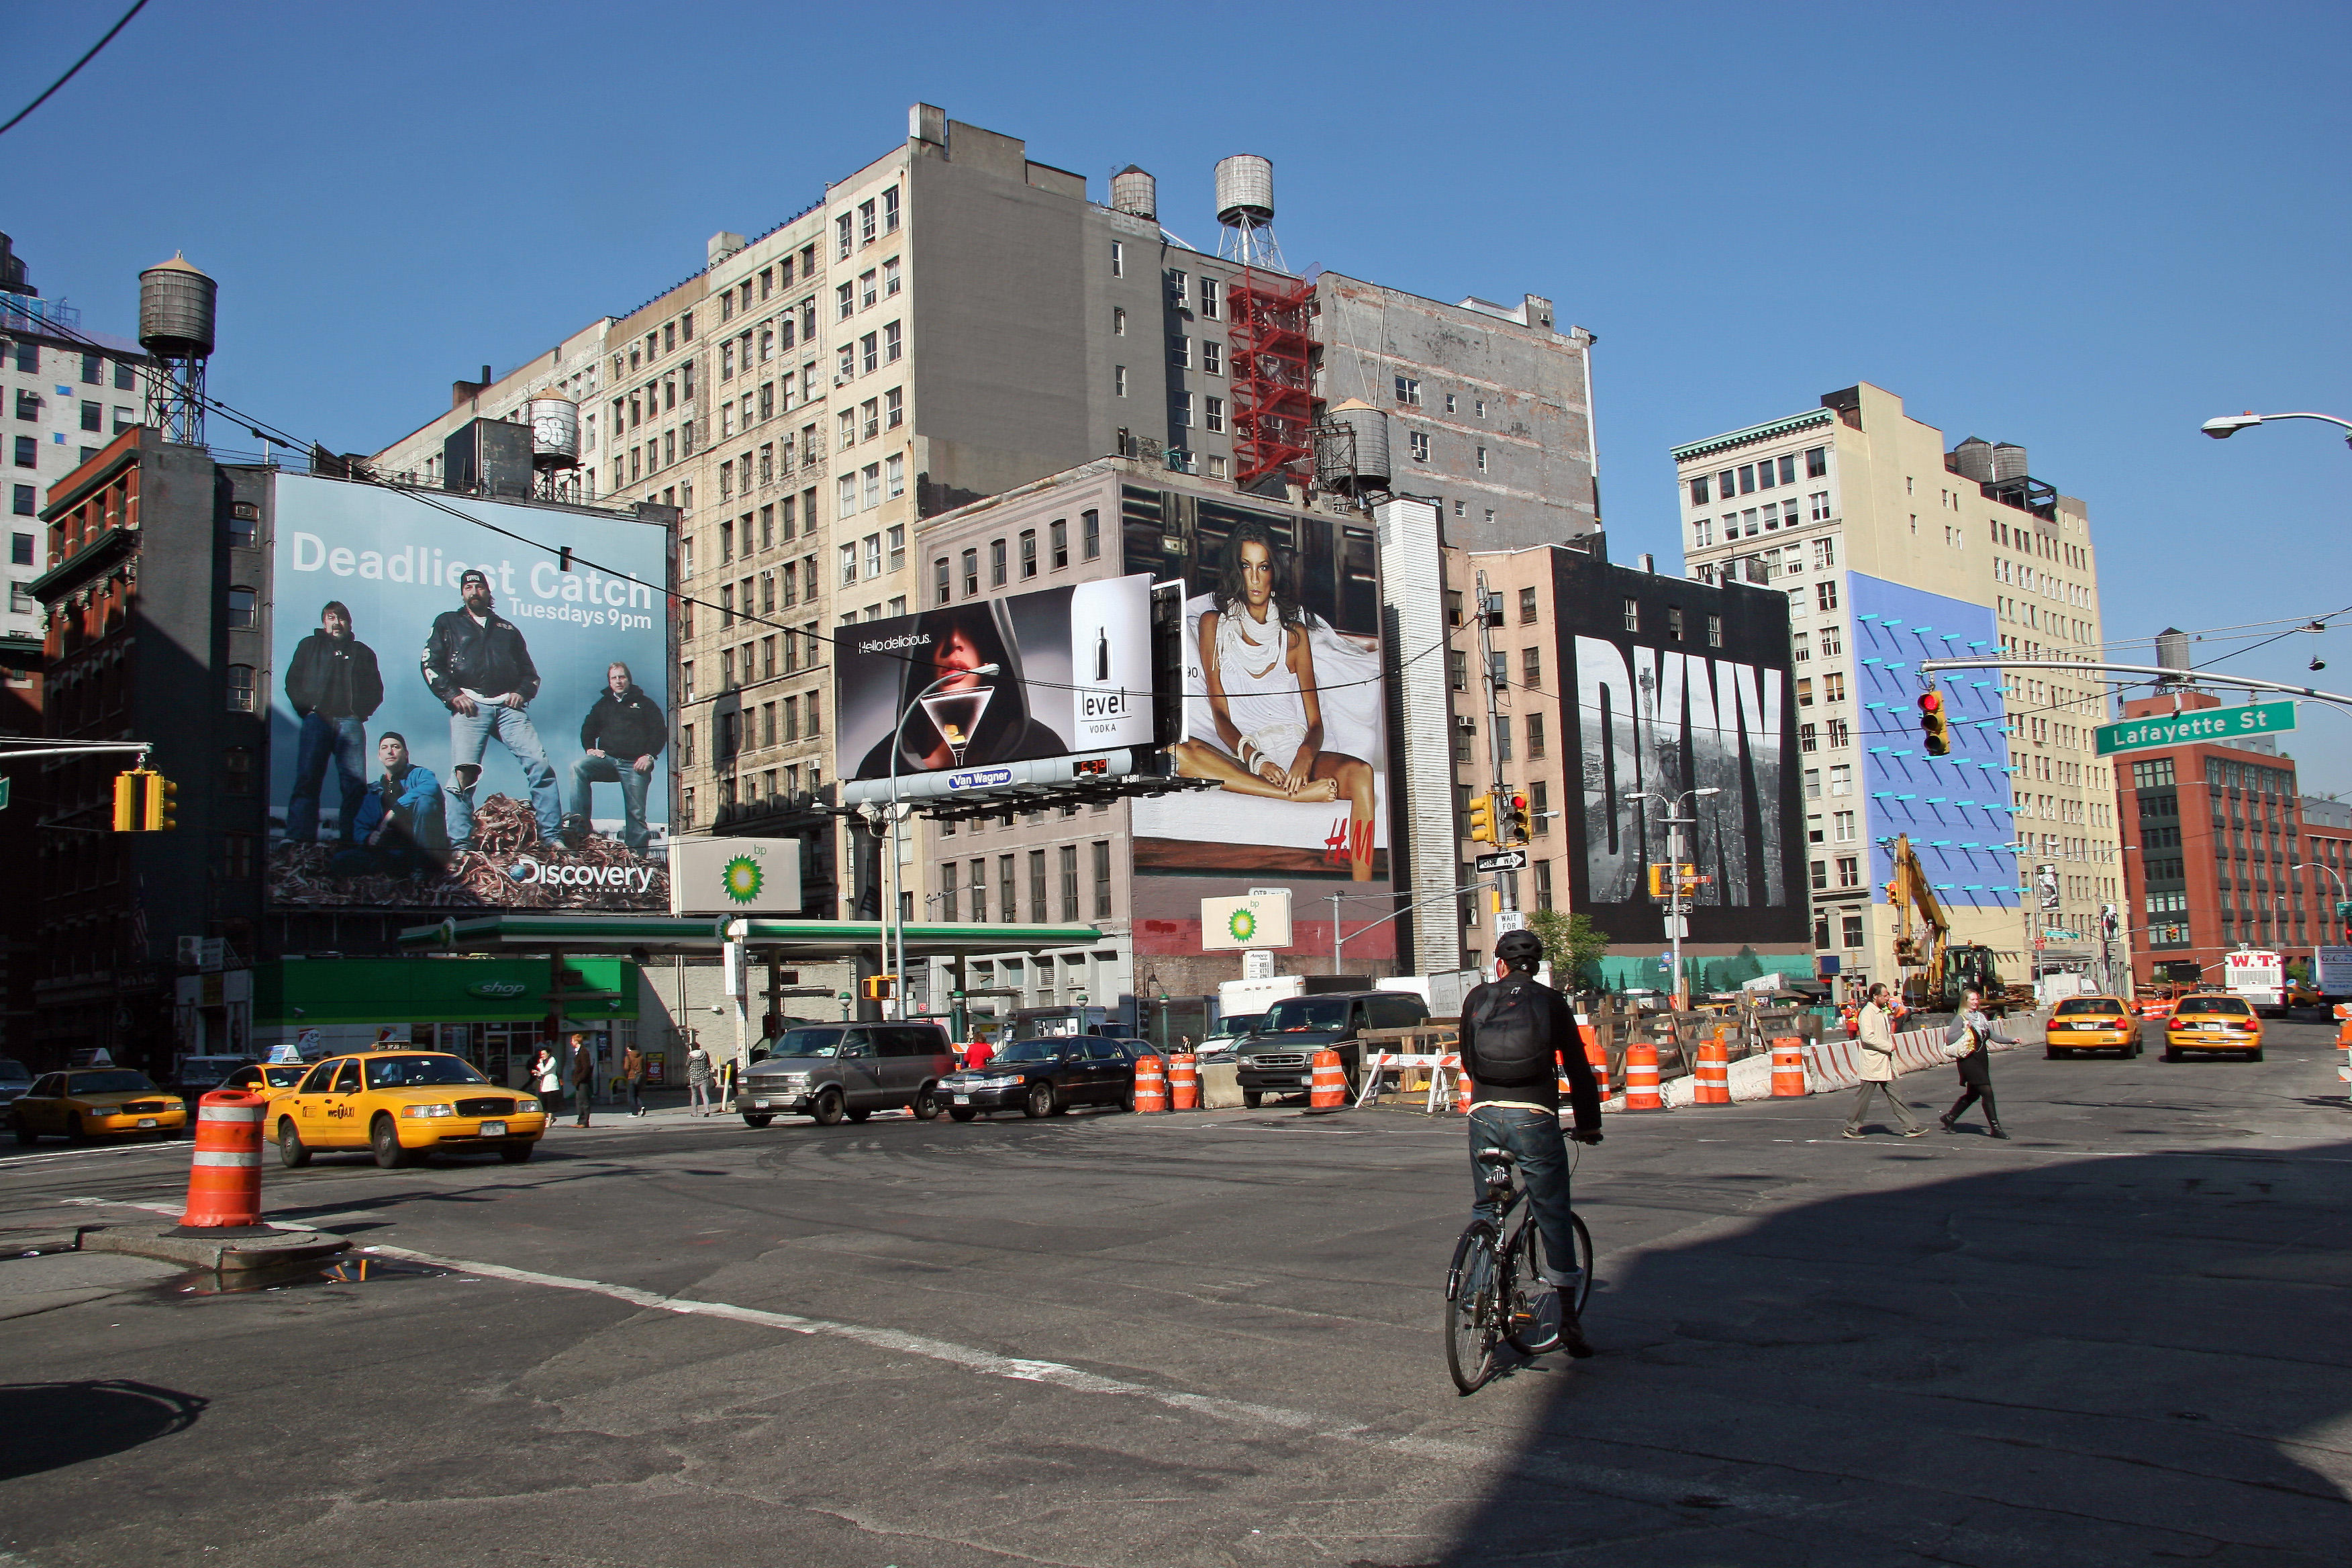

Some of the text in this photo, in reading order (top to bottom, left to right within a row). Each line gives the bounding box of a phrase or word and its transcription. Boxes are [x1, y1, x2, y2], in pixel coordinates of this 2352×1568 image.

[293, 530, 652, 610] Deadliest Catch
[509, 597, 652, 631] Tuesdays 9pm
[859, 639, 884, 654] Hello
[1081, 686, 1126, 716] level
[1089, 723, 1117, 734] VODKA
[2114, 710, 2267, 742] Lafayette St
[953, 771, 1009, 786] Van Wagner
[753, 844, 767, 856] bp
[1324, 818, 1374, 867] H&M
[1483, 856, 1519, 867] ONE WAY
[1250, 900, 1260, 909] bp
[1500, 914, 1518, 922] WAIT
[480, 981, 526, 996] shop
